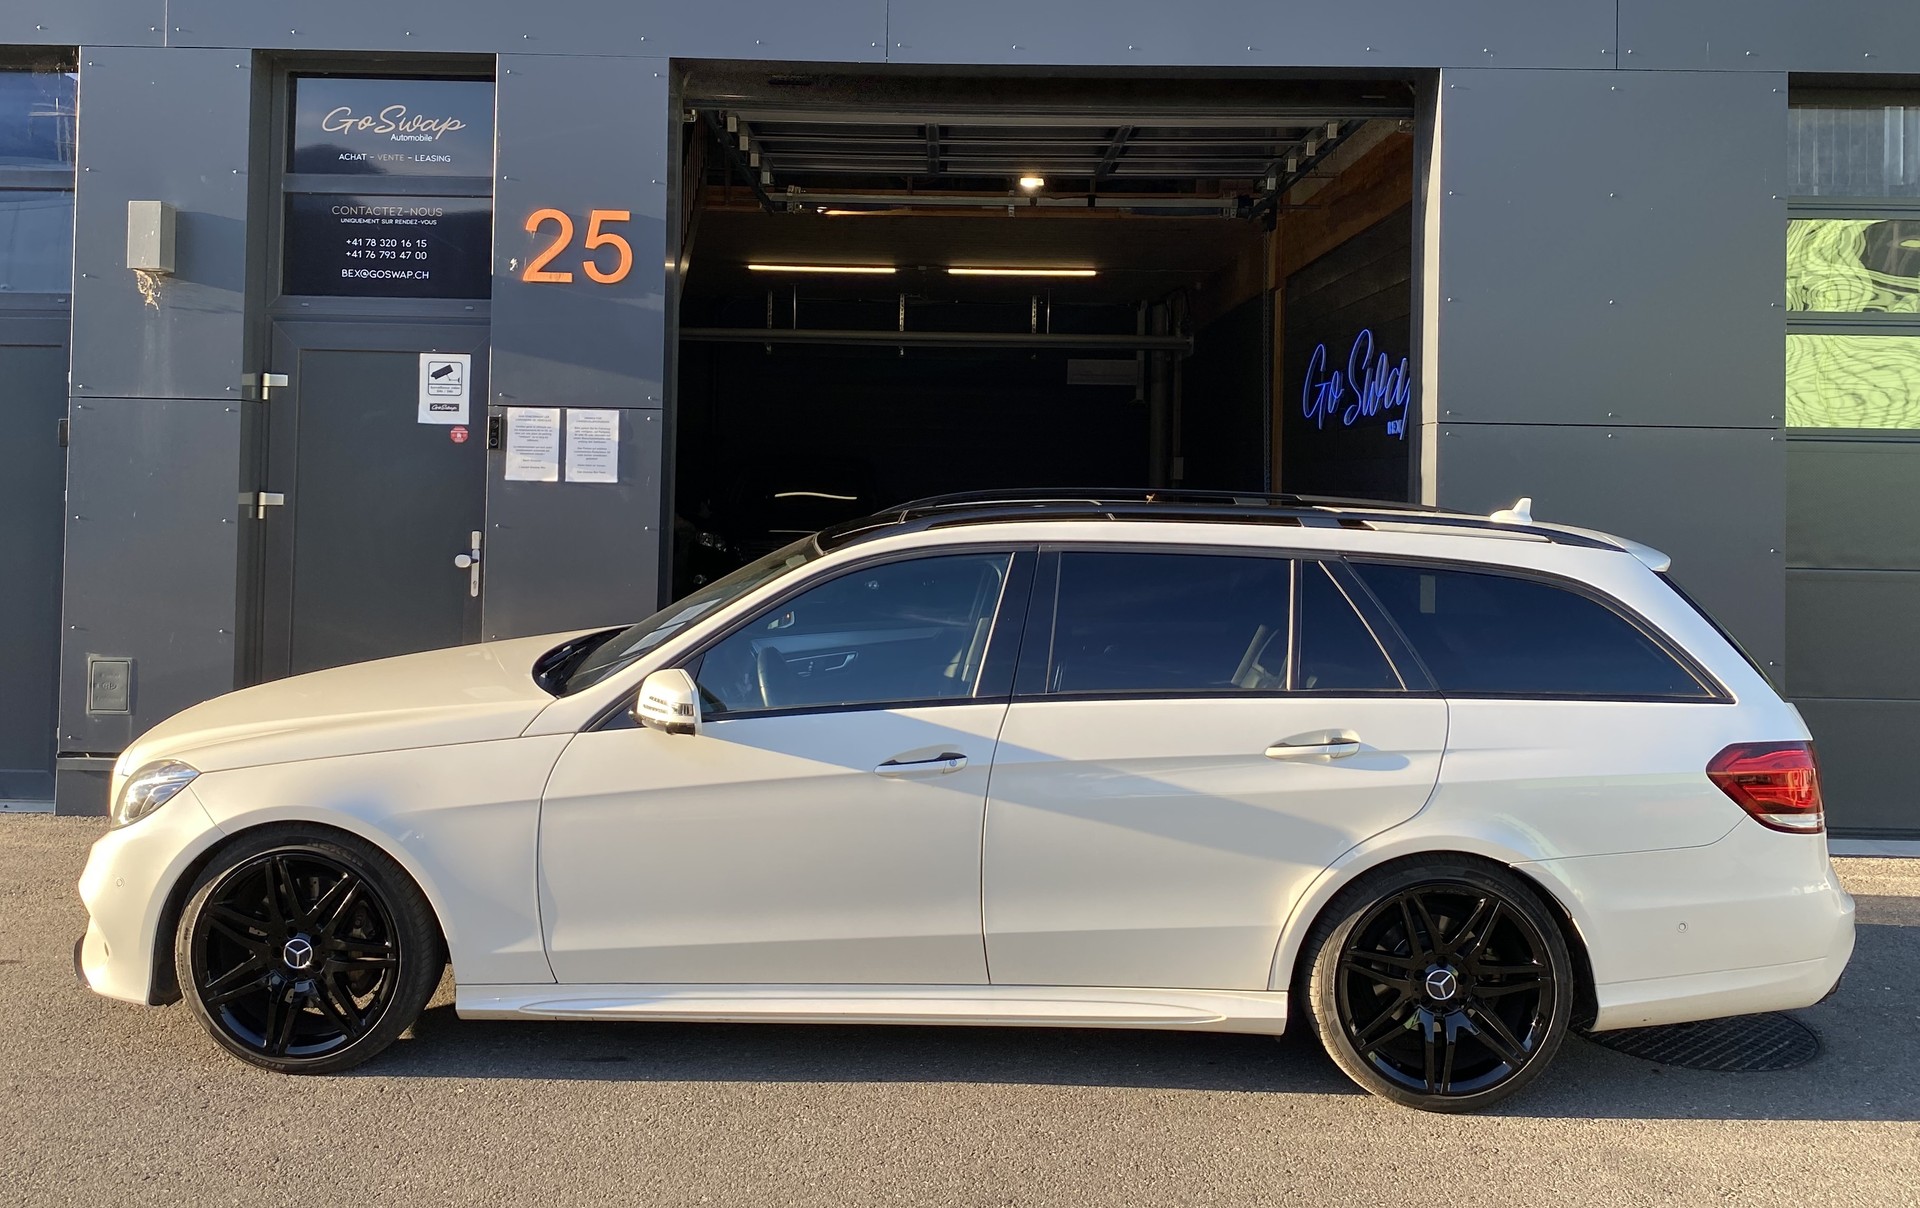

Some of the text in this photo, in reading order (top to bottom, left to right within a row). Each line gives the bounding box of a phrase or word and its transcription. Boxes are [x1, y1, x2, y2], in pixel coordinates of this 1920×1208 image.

[390, 133, 433, 142] Automobile
[338, 153, 367, 161] ACHAT
[377, 153, 405, 161] VENTE
[415, 154, 451, 162] LEASING
[331, 205, 443, 217] CONTACTEZ-NOUS
[346, 238, 427, 248] +41 78 320 16 15
[522, 208, 633, 284] 25
[345, 250, 427, 260] +41 76 793 47 00
[341, 268, 430, 279] BEX@GOSWAP.CH
